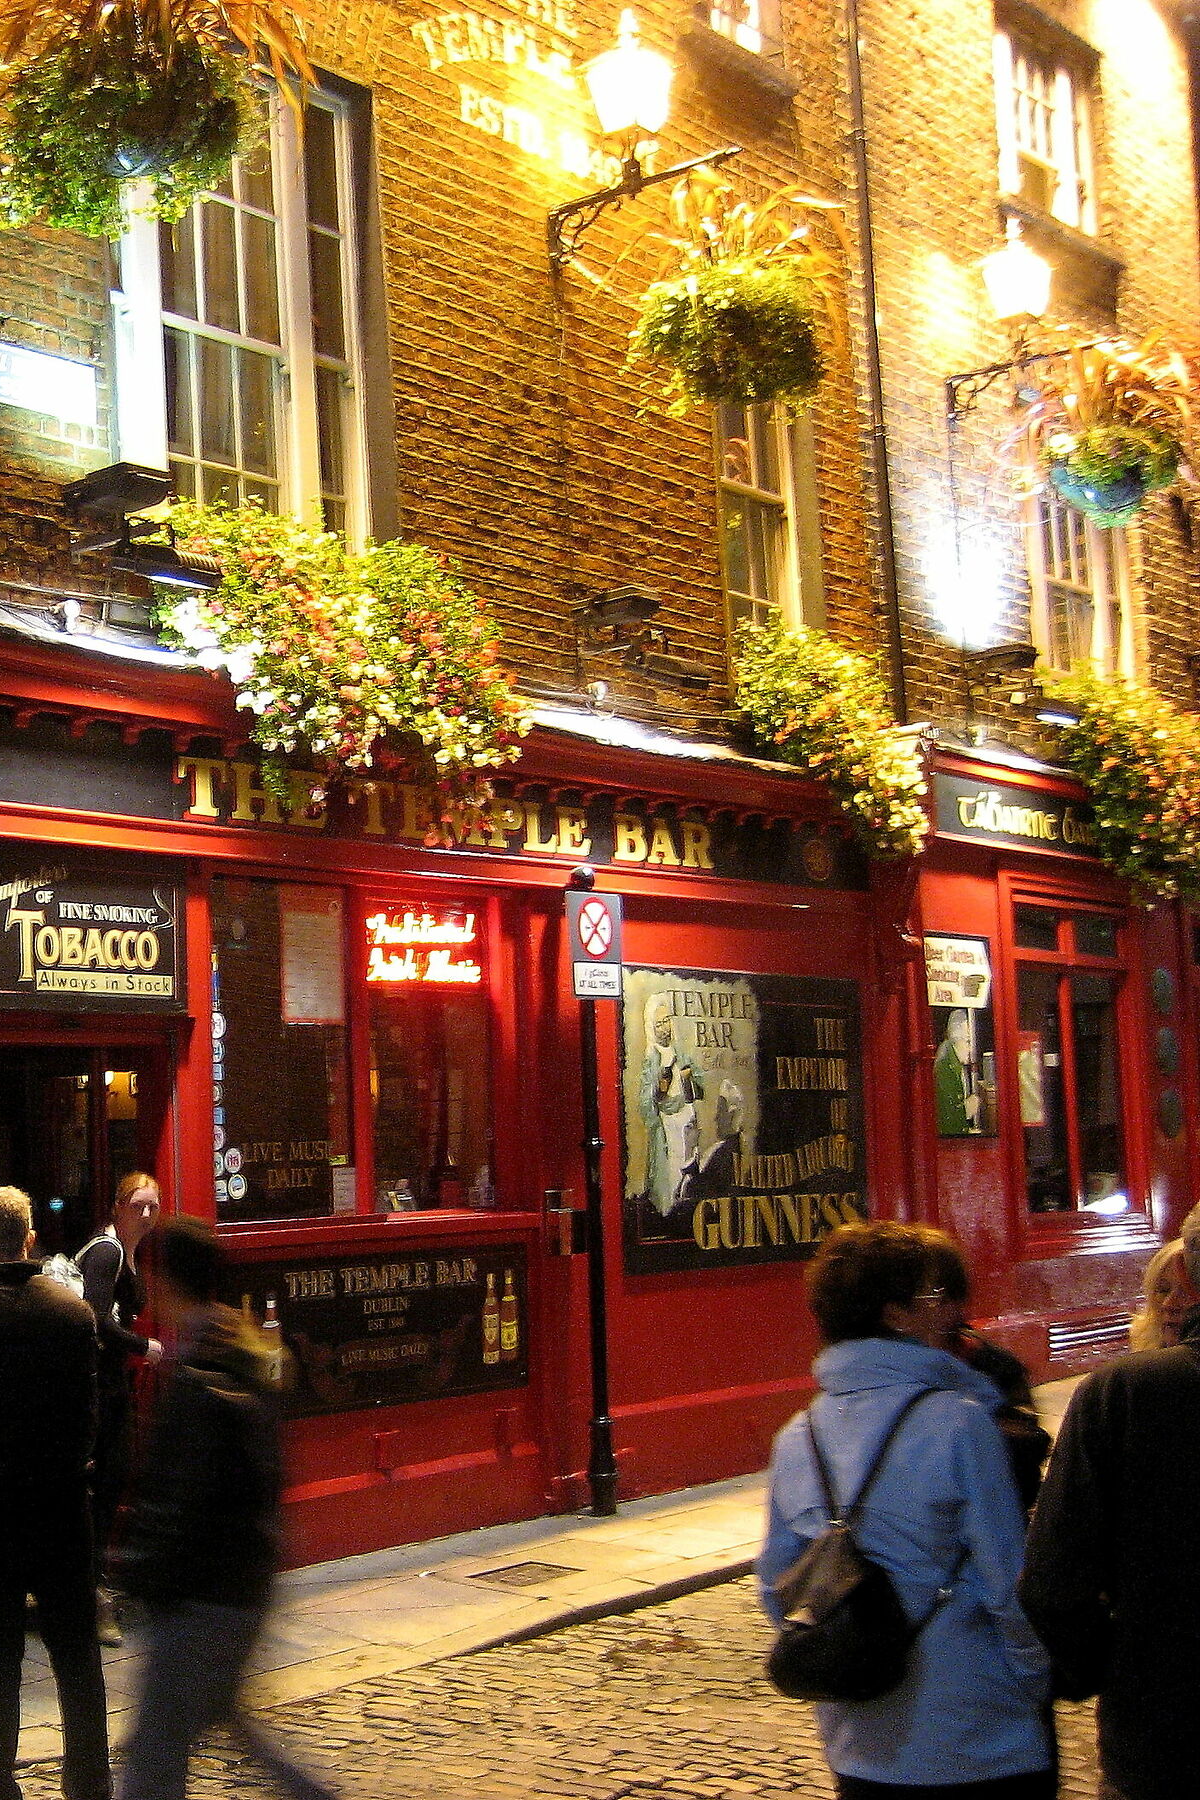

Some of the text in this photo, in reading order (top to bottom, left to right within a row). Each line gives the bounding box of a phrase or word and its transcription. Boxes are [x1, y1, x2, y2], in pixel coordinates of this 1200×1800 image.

[177, 755, 715, 870] THE TEMPLE BAR
[34, 890, 54, 904] OF
[58, 902, 158, 925] FINE SMOKING
[5, 909, 161, 982] TOBACCO
[38, 971, 97, 990] Always
[105, 976, 119, 990] in
[666, 988, 754, 1020] TEMPLE
[694, 1021, 737, 1052] BAR
[241, 1142, 283, 1163] LIVE
[692, 1192, 868, 1250] GUINNESS
[285, 1258, 478, 1298] THE TEMPLE BAR
[363, 1296, 410, 1314] DUBLIN
